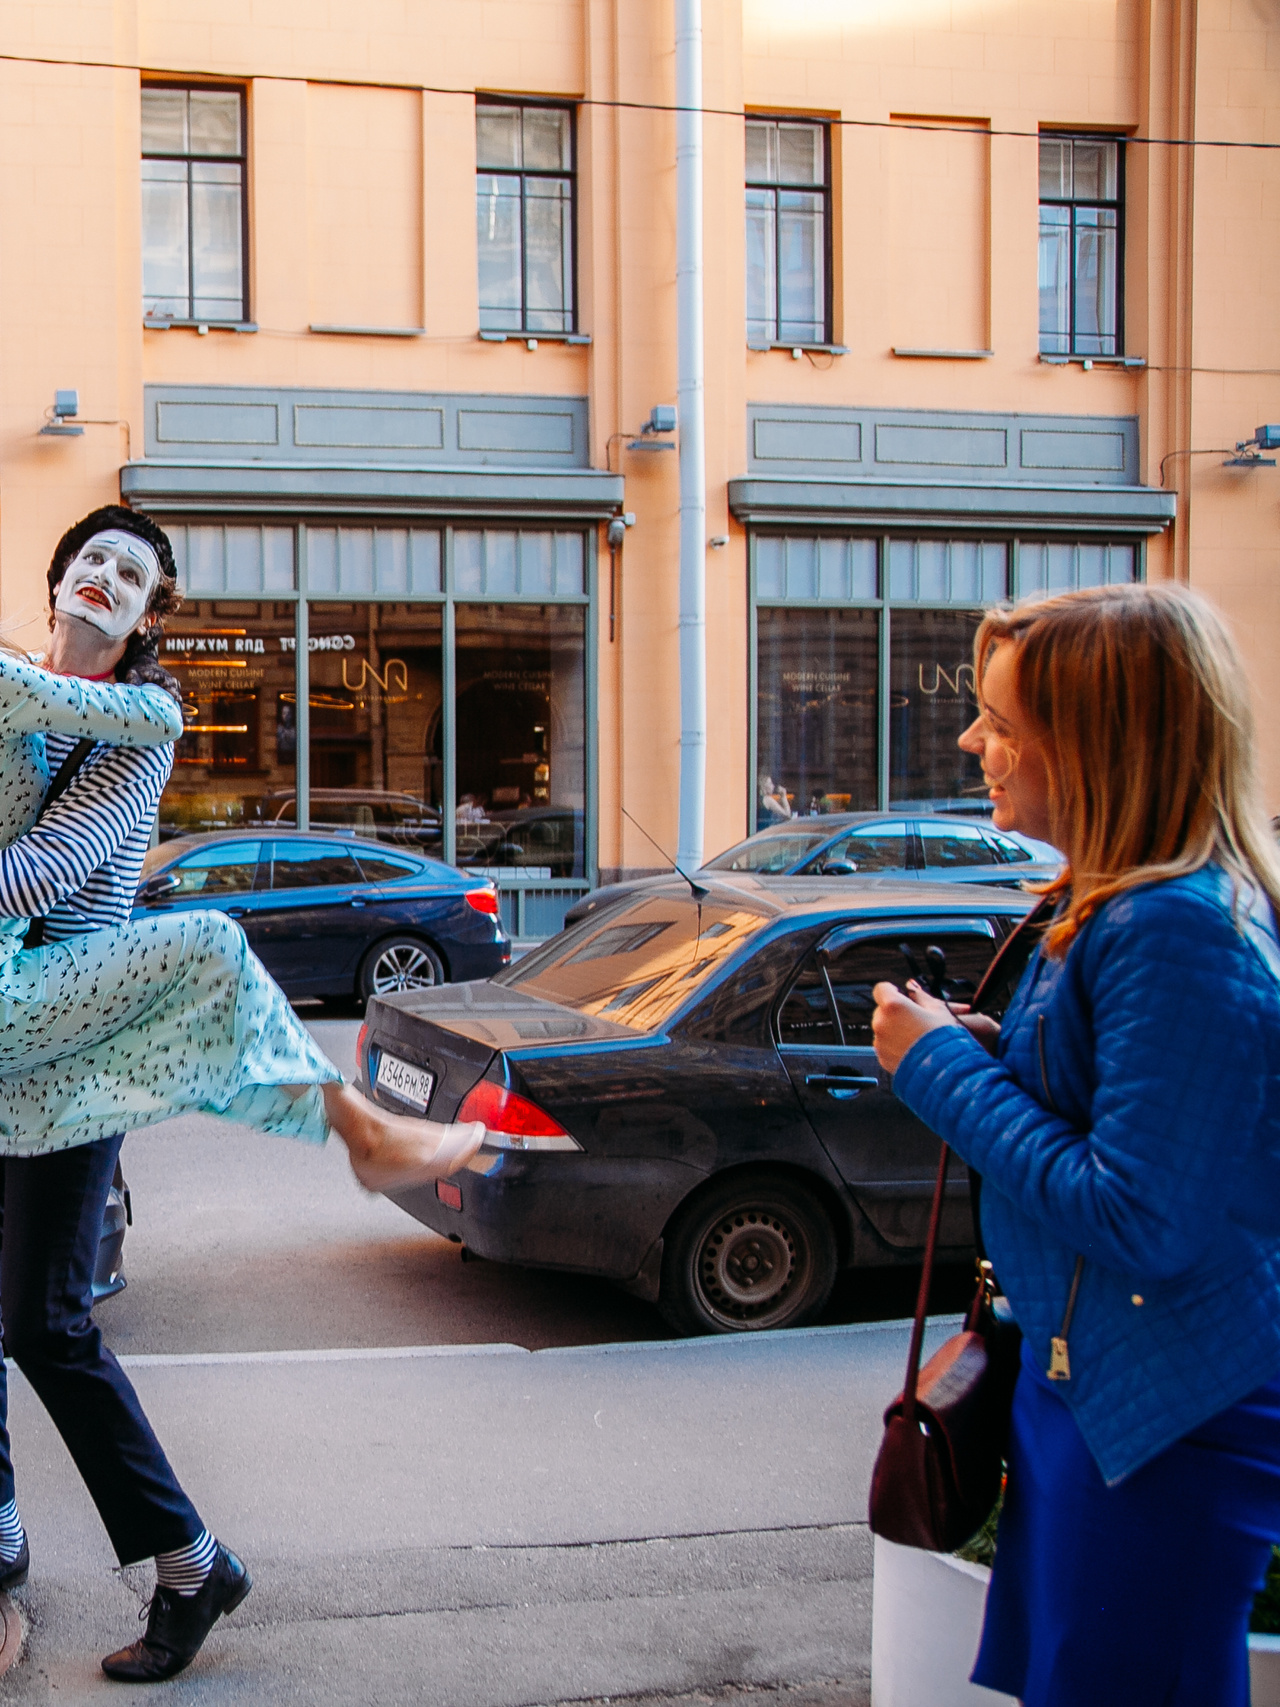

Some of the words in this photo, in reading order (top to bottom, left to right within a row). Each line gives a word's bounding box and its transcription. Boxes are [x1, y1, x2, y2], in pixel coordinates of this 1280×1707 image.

[188, 668, 228, 678] MODERN
[229, 668, 264, 678] CUISINE
[199, 680, 222, 690] WINE
